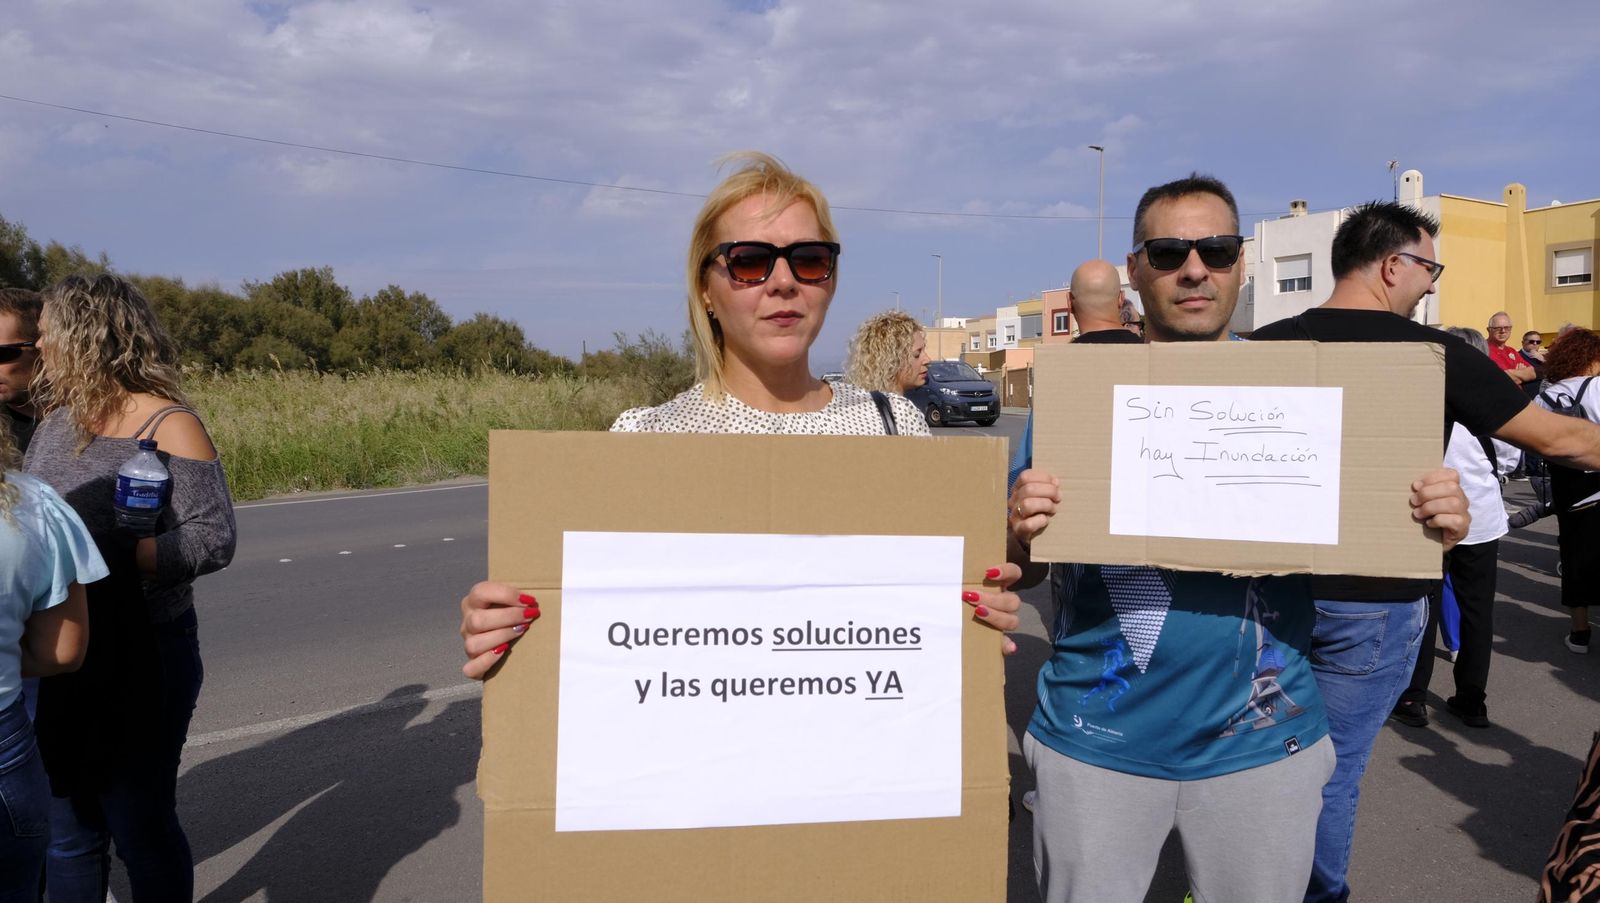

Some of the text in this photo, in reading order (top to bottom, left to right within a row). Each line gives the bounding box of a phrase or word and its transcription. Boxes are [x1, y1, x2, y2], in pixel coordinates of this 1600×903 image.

[1126, 396, 1286, 423] Sin Solución
[1140, 437, 1319, 480] hay Inundación
[607, 620, 922, 650] Queremos soluciones
[634, 670, 904, 705] y las queremos YA
